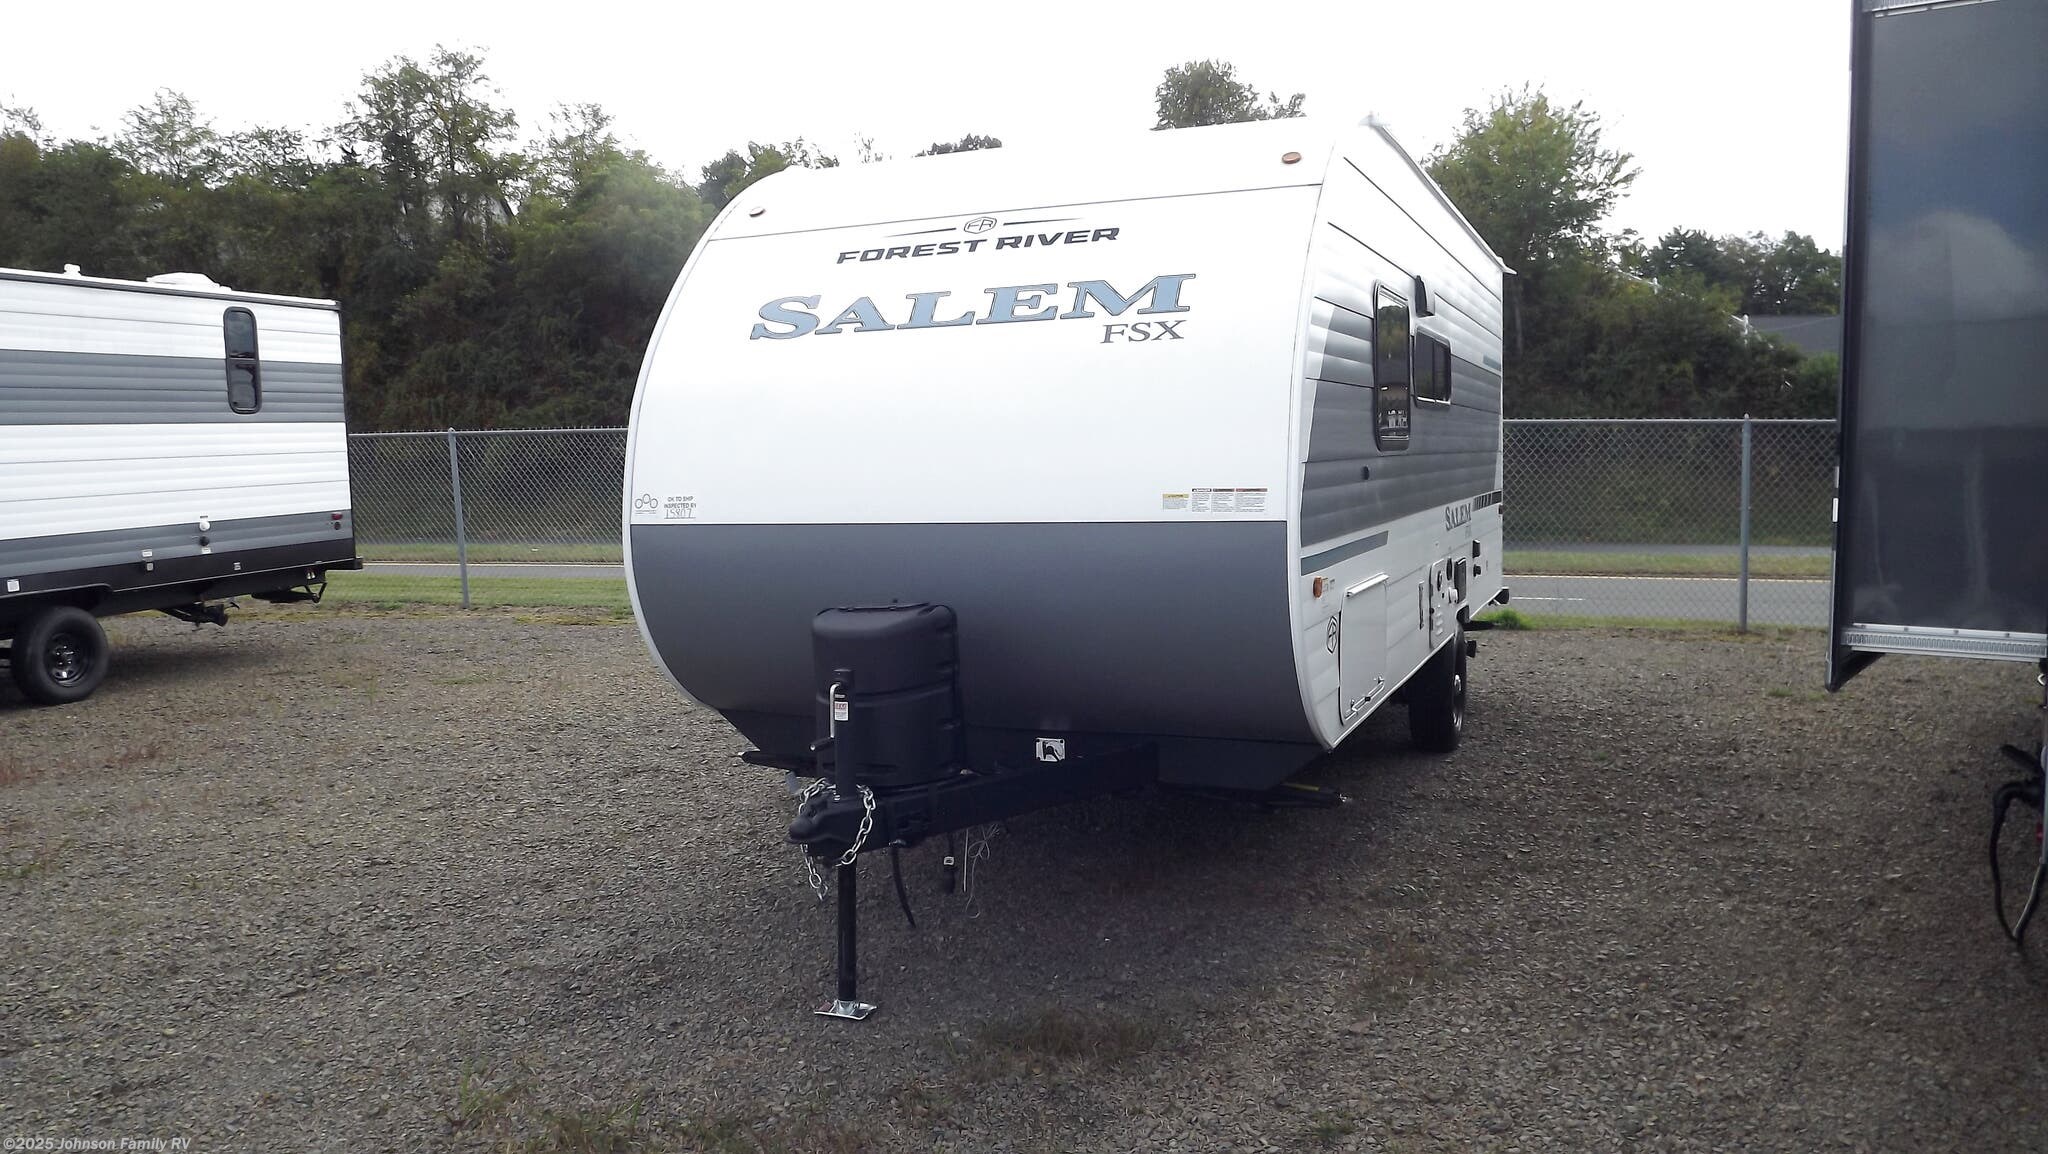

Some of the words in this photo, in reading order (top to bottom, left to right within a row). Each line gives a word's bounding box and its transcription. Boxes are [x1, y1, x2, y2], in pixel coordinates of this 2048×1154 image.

[836, 238, 988, 264] FOREST
[995, 227, 1120, 251] RIVER
[750, 273, 1196, 340] SALEM
[1100, 319, 1187, 344] FSX
[1445, 503, 1472, 531] SALEM
